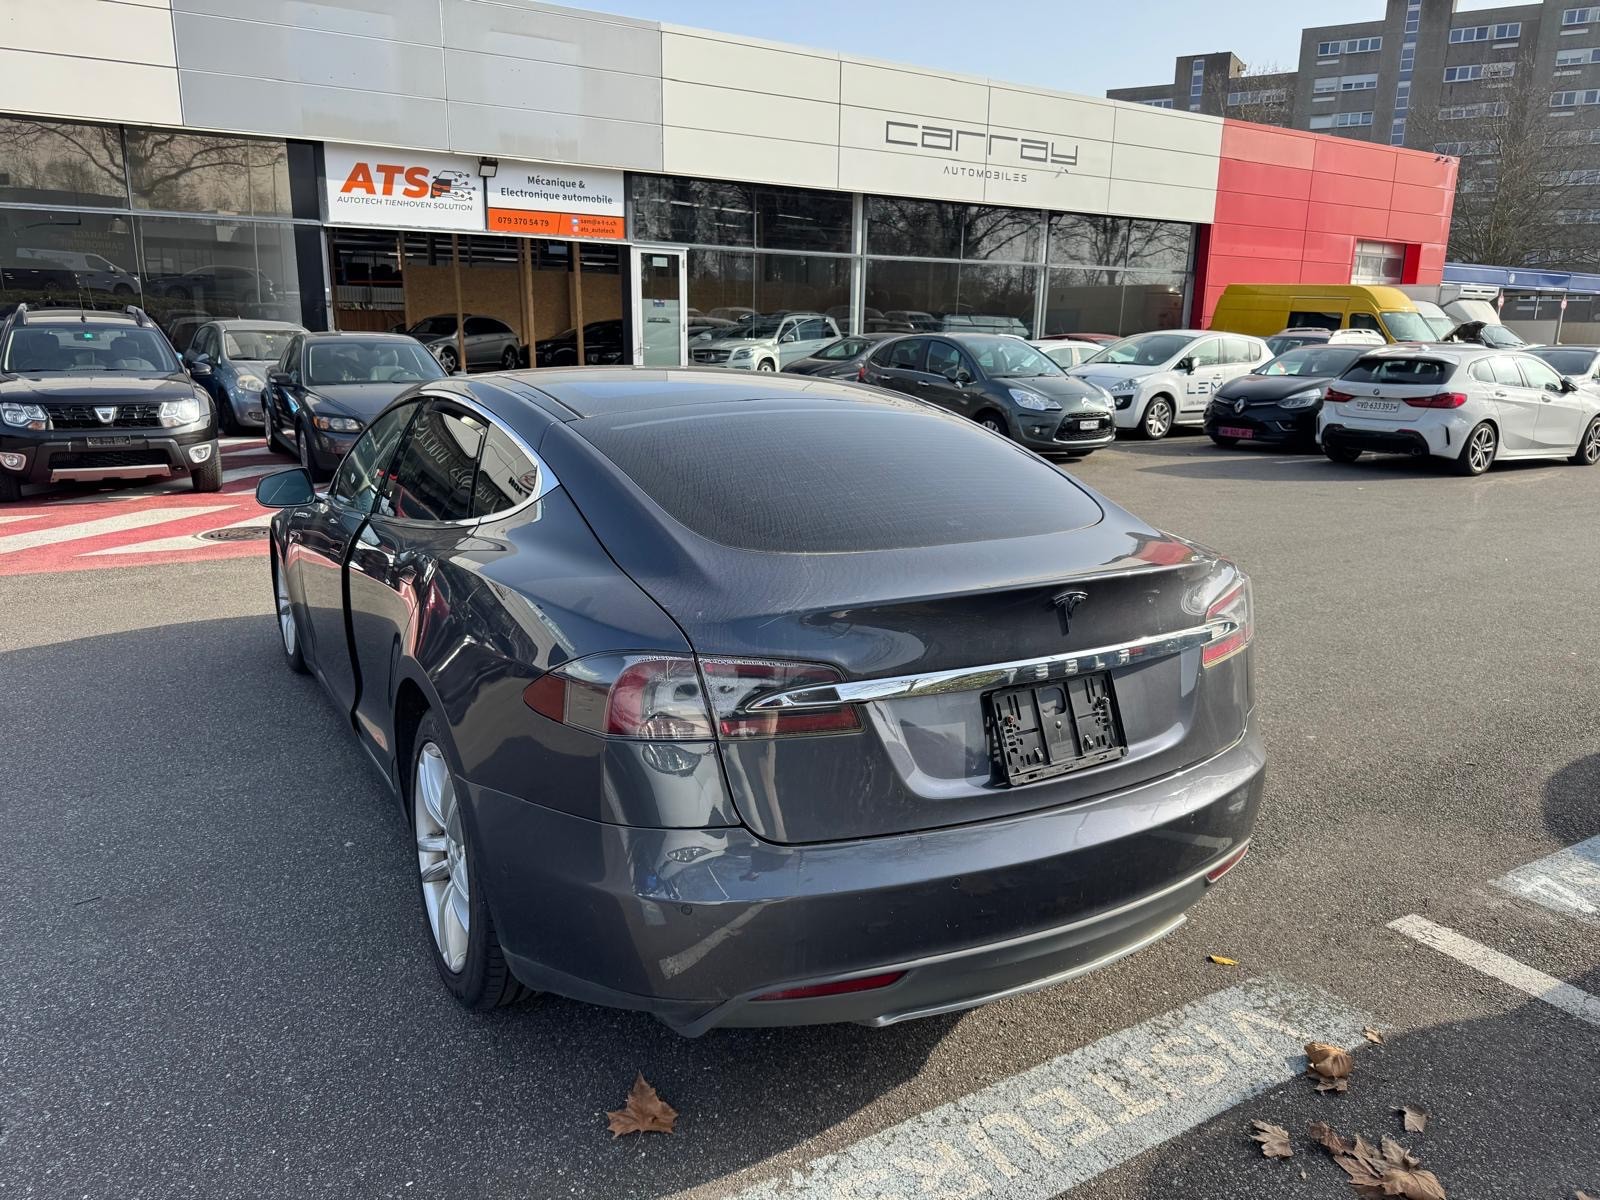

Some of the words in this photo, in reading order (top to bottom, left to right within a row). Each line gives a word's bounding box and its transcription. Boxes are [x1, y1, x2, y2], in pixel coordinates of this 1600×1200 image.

[886, 121, 1078, 166] carray
[340, 162, 430, 198] ATS
[527, 175, 577, 189] Mécanique
[578, 180, 586, 189] &
[943, 165, 1028, 183] AUTOMOBILES
[337, 196, 382, 205] AUTOTECH
[385, 199, 432, 208] TIENHOVEN
[433, 202, 473, 211] SOLUTION
[500, 187, 560, 201] Electronique
[562, 193, 613, 205] automobile
[497, 216, 512, 225] 079
[513, 217, 528, 225] 370
[529, 218, 538, 226] 54
[540, 219, 550, 227] 79
[1007, 648, 1130, 684] TESLA
